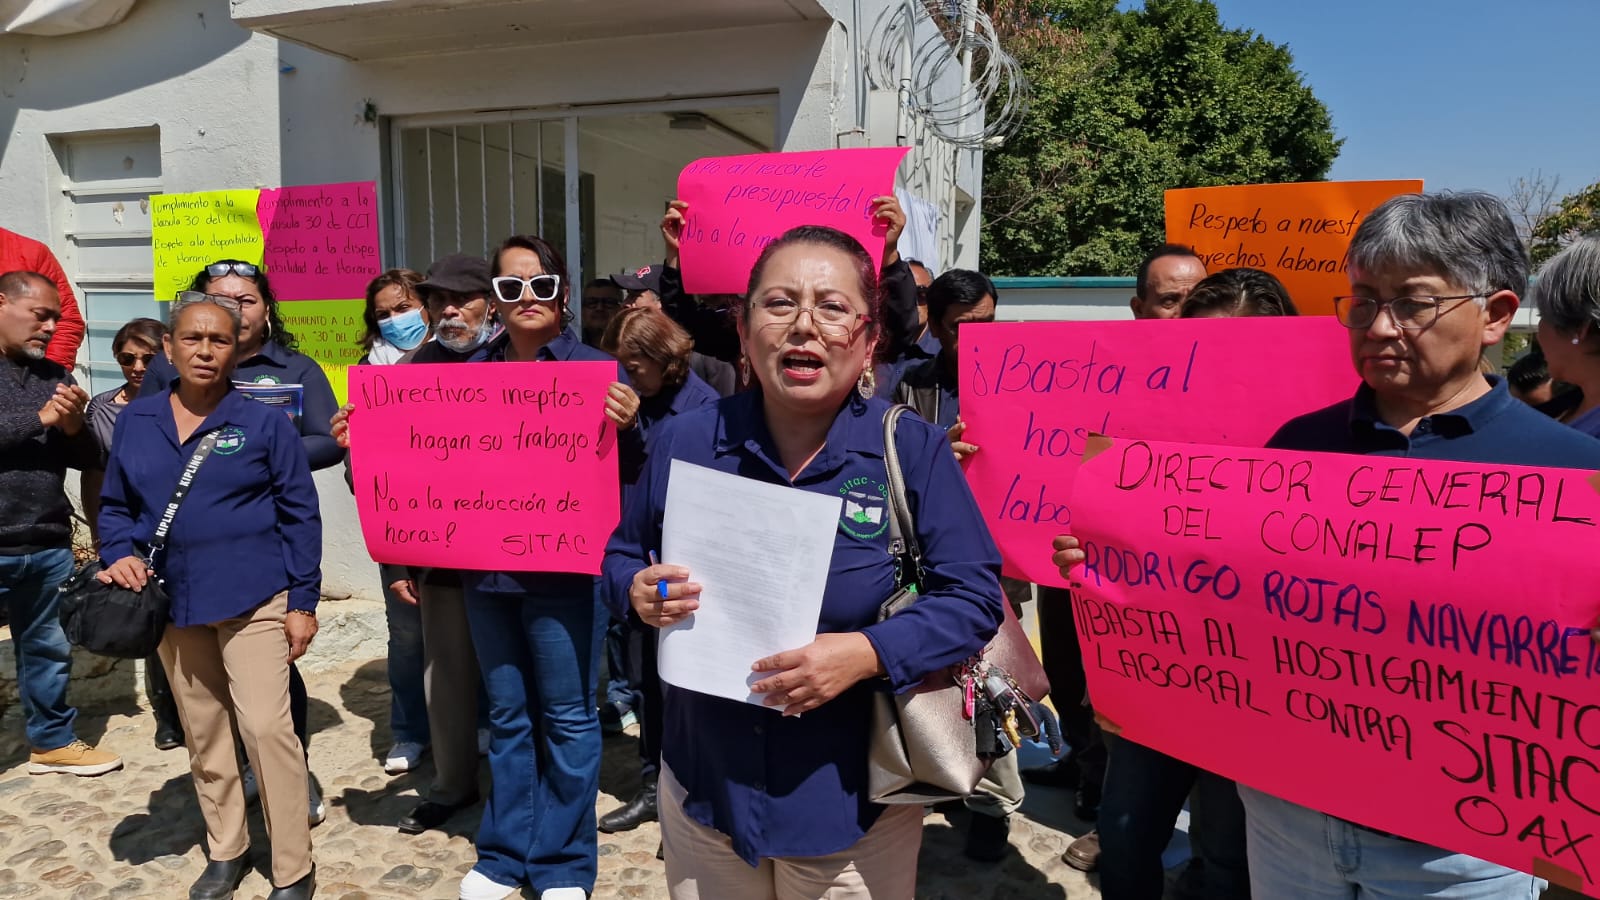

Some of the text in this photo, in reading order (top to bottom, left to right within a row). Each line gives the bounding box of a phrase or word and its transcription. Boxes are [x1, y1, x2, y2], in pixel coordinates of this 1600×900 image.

[756, 157, 828, 178] recorte
[215, 200, 221, 208] a
[225, 193, 234, 208] la
[341, 197, 350, 207] a
[357, 185, 369, 208] la
[183, 215, 200, 226] 30
[206, 212, 221, 225] del
[304, 215, 322, 230] 30
[327, 210, 342, 230] de
[346, 213, 370, 229] CCT
[711, 228, 720, 243] a
[728, 216, 746, 247] la
[1189, 203, 1360, 239] Respeto a nuest
[157, 255, 168, 268] de
[312, 245, 319, 254] a
[326, 236, 337, 255] la
[1191, 243, 1268, 268] erechos
[315, 260, 329, 275] de
[1146, 340, 1199, 393] al
[359, 369, 489, 411] ¡Directivos
[502, 377, 585, 415] ineptos
[410, 425, 471, 462] hagan
[477, 433, 504, 453] su
[179, 453, 205, 488] KIPLING
[1114, 440, 1598, 527] DIRECTOR GENERAL
[373, 471, 582, 514] No a la reducción de
[155, 501, 180, 538] KIPLING
[500, 532, 590, 556] SITAC
[1163, 504, 1493, 572] DEL CONALEP
[1083, 540, 1242, 601] RODRIGO
[1262, 569, 1387, 636] ROJAS
[1203, 617, 1249, 661] AL
[1272, 634, 1600, 751] HOSTIGAMIENTO
[1096, 641, 1600, 818] LABORAL CONTRA SITAC
[1454, 795, 1595, 886] OAX
